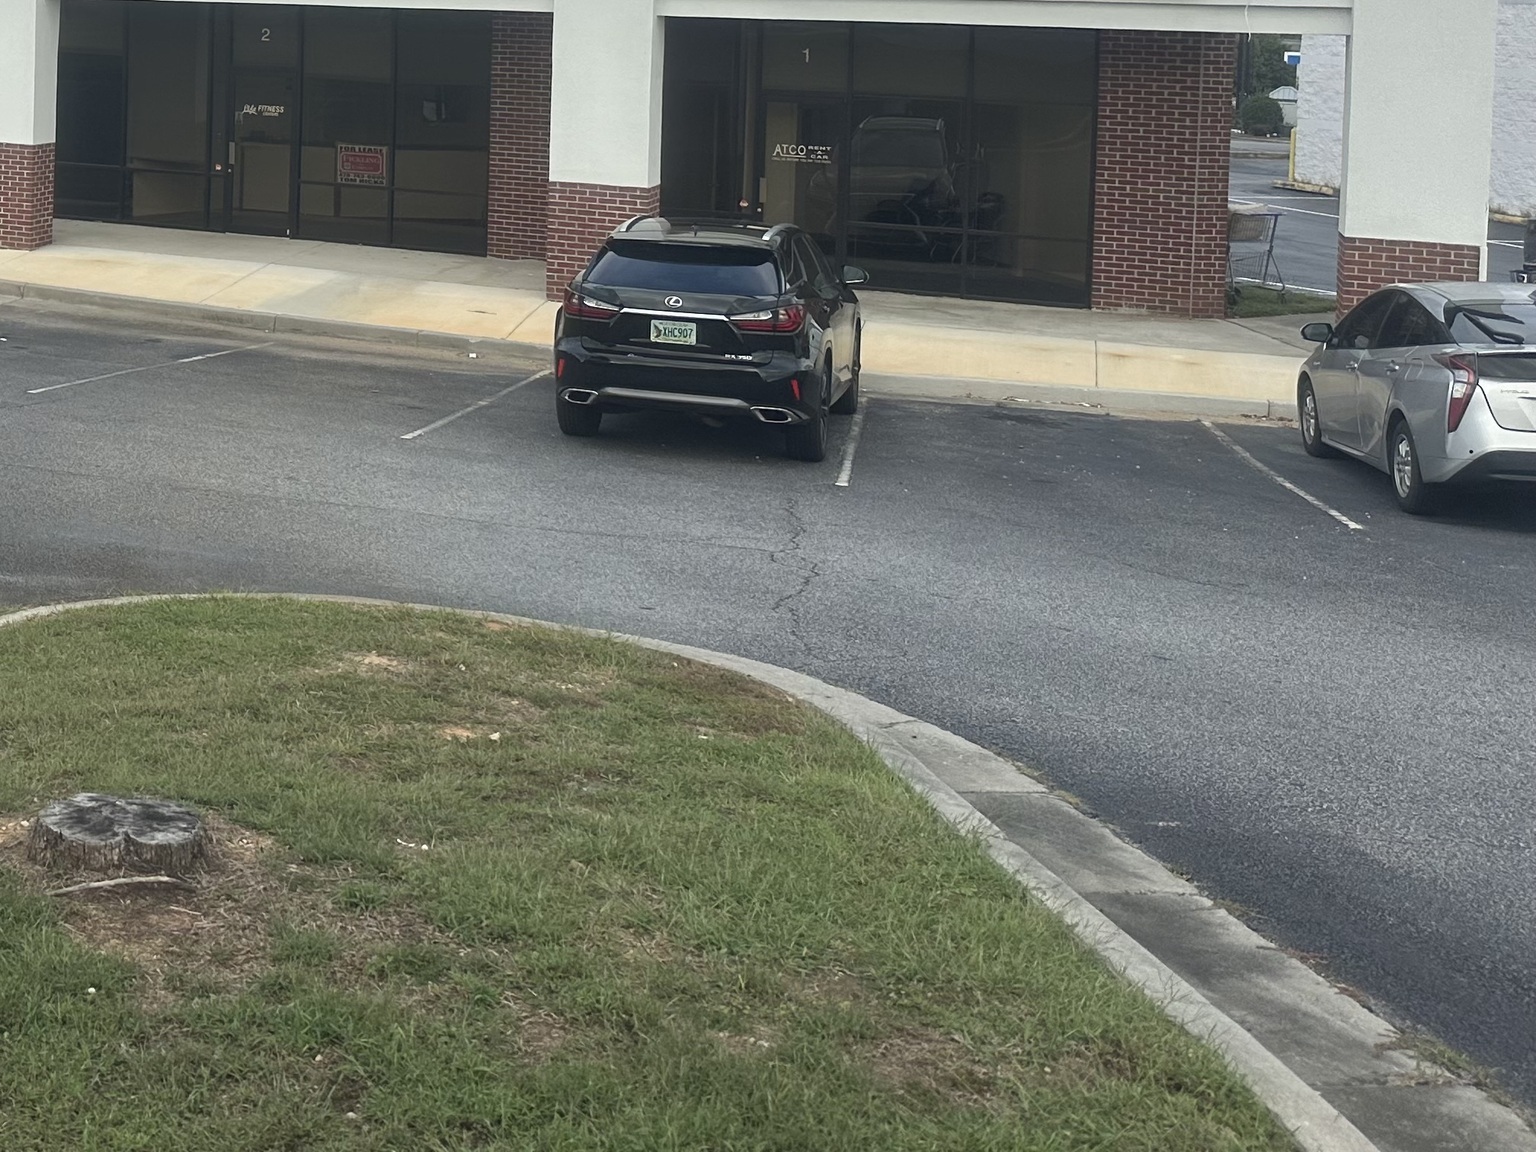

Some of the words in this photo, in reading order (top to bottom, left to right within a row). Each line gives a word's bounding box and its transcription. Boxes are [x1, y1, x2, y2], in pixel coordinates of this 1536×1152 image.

[261, 28, 271, 42] 2
[802, 48, 810, 63] 1
[258, 105, 285, 114] FITNESS
[339, 145, 356, 153] FOR
[772, 143, 807, 156] ATCO
